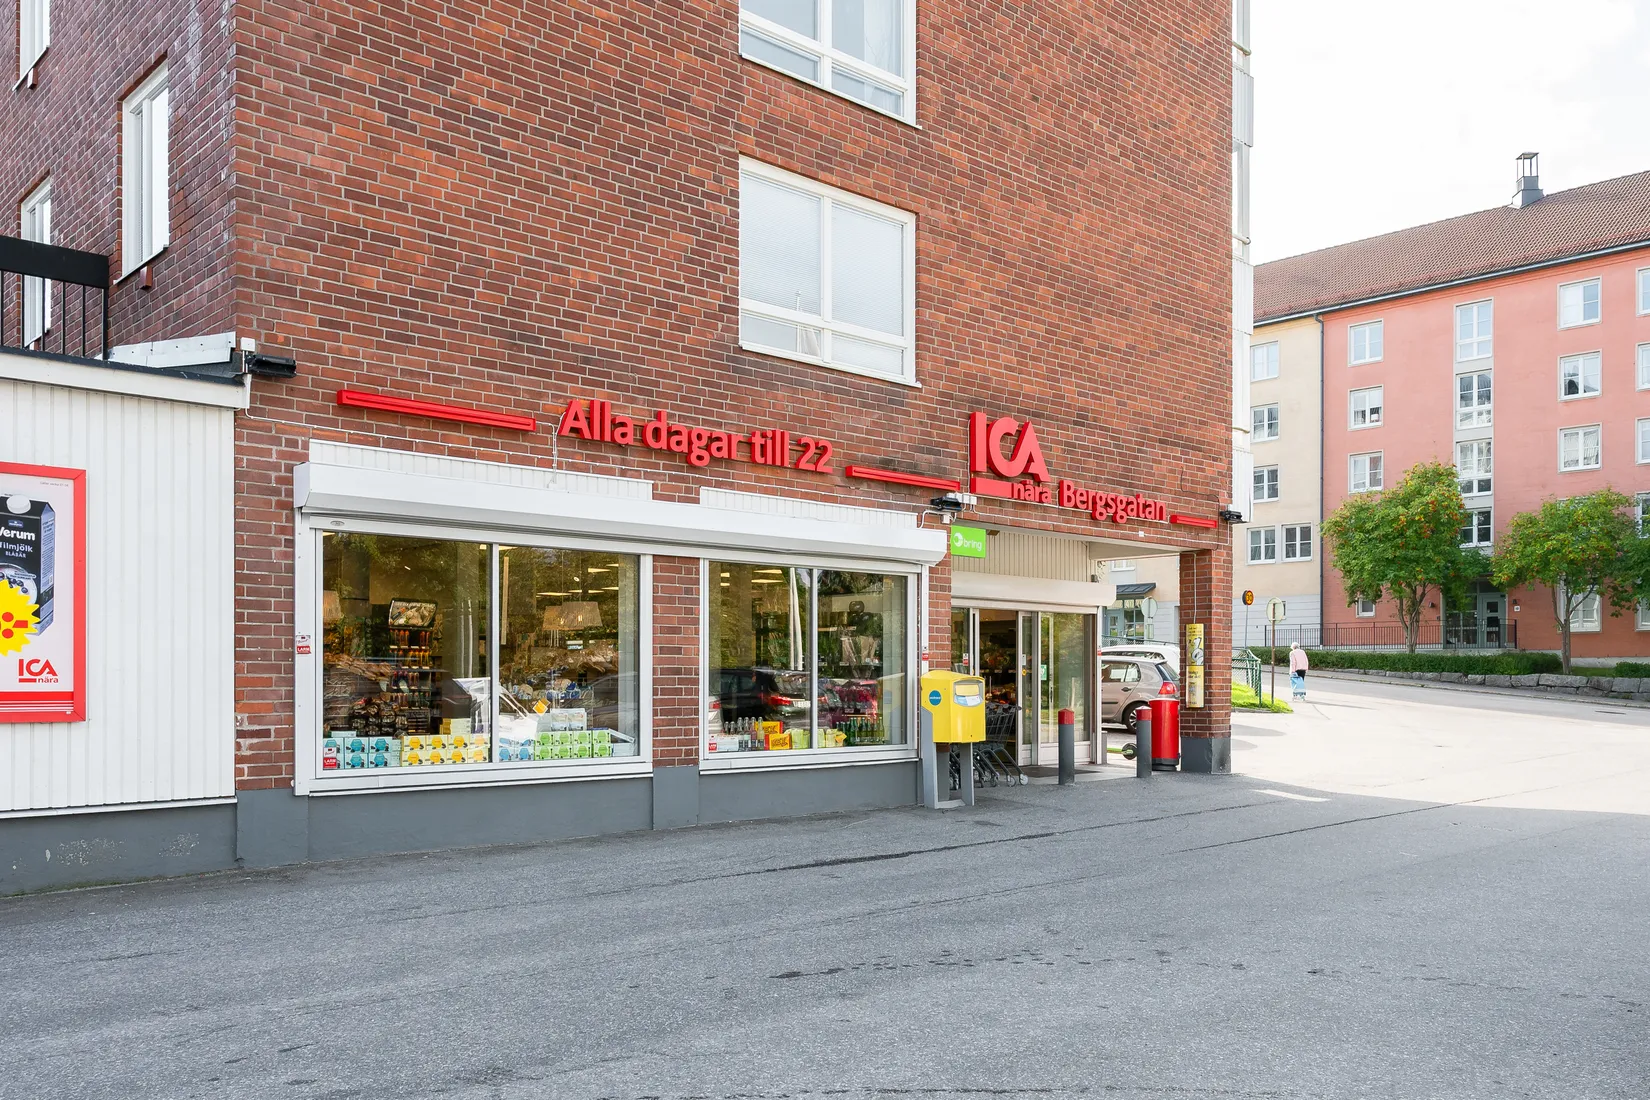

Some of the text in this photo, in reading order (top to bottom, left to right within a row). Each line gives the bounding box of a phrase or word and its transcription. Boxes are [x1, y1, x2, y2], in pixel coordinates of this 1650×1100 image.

[558, 400, 833, 473] Alla dagar till 22
[970, 411, 1049, 482] ICA
[1012, 480, 1166, 523] nära Bergsgatan
[964, 538, 982, 552] bring
[18, 658, 58, 677] ICA
